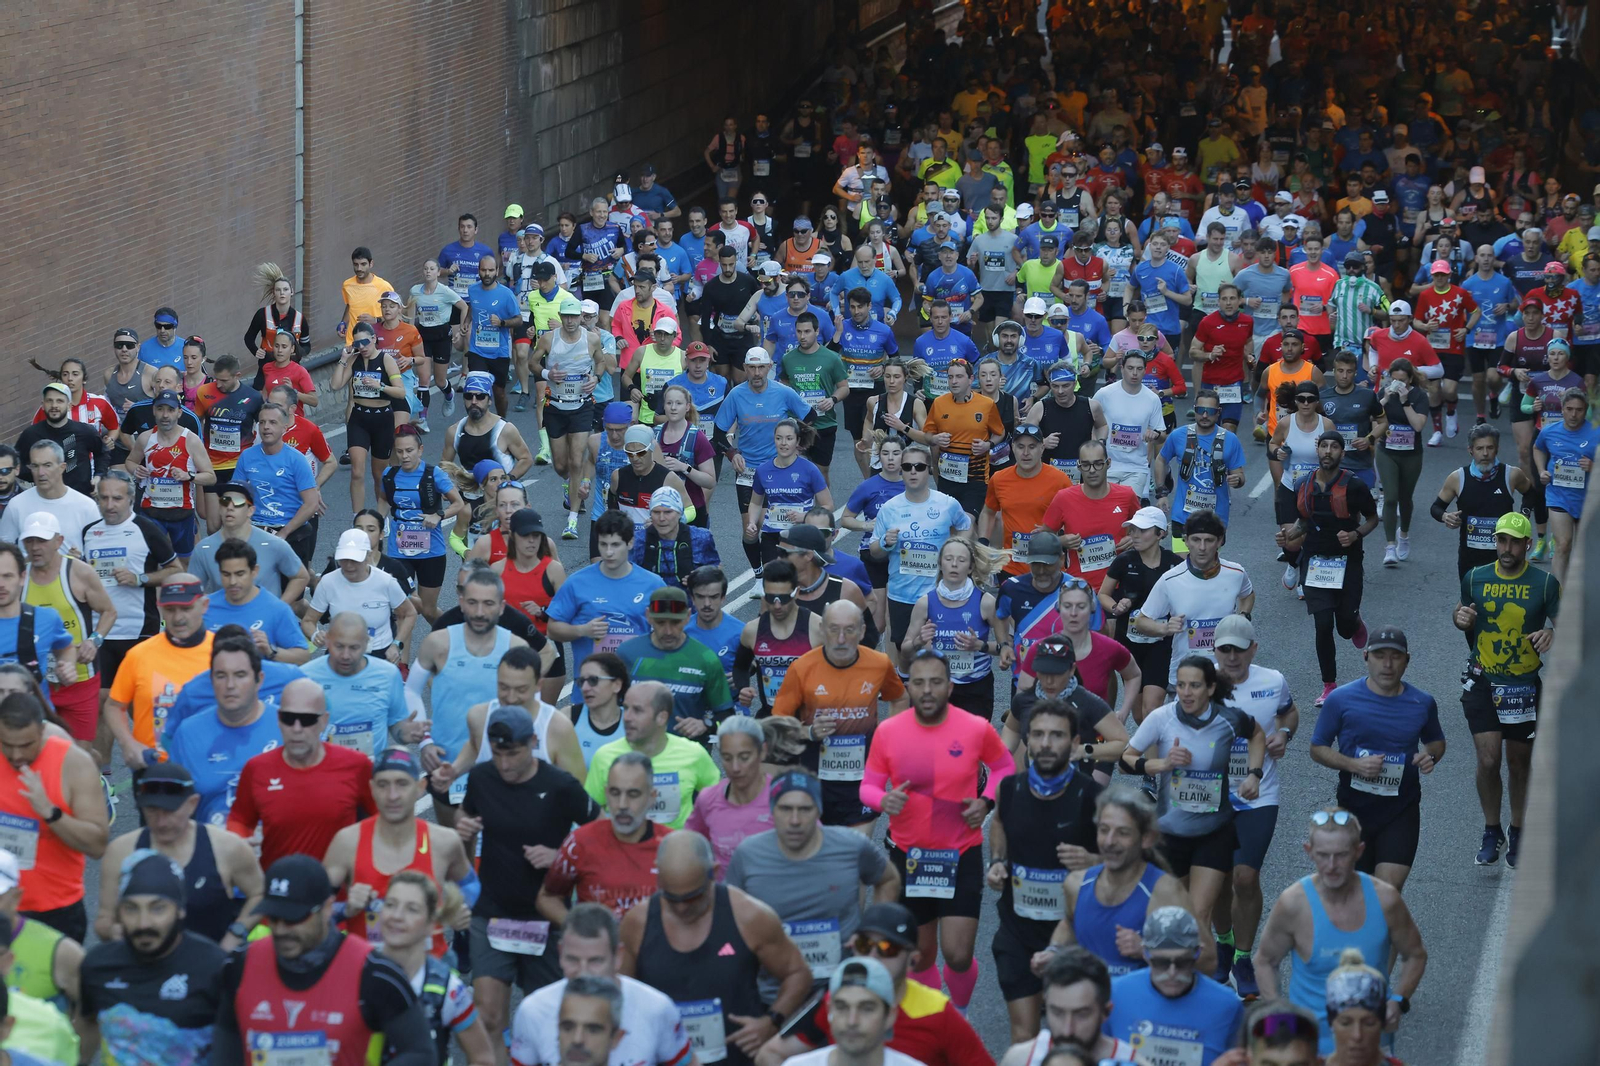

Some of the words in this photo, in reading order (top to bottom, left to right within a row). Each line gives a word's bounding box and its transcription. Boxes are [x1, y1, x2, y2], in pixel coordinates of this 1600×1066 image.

[1165, 251, 1188, 269] NGARY
[214, 437, 237, 446] MARCO
[1113, 438, 1137, 447] MICHAEL
[943, 468, 962, 476] JAMES
[1088, 535, 1109, 544] ZURICH
[1467, 534, 1491, 543] MARCOS
[400, 541, 424, 550] SOPHIE
[913, 542, 935, 550] ZURICH
[101, 549, 123, 557] ZURICH
[1088, 551, 1117, 563] FONSECA
[1315, 574, 1335, 583] SINGH
[1482, 583, 1531, 600] POPEYE
[1506, 685, 1531, 694] ZURICH
[339, 724, 368, 733] ZURICH
[833, 737, 860, 746] ZURICH
[822, 758, 862, 770] RICARDO
[653, 773, 673, 783] RICH
[1190, 771, 1218, 779] ZURICH
[1179, 790, 1212, 803] ELAINE
[924, 850, 954, 860] ZURICH
[915, 875, 950, 888] AMADEO
[1029, 873, 1063, 882] ZURICH
[1022, 894, 1058, 909] TOMMI
[795, 922, 832, 933] ZURICH
[1156, 1025, 1199, 1039] ZURICH
